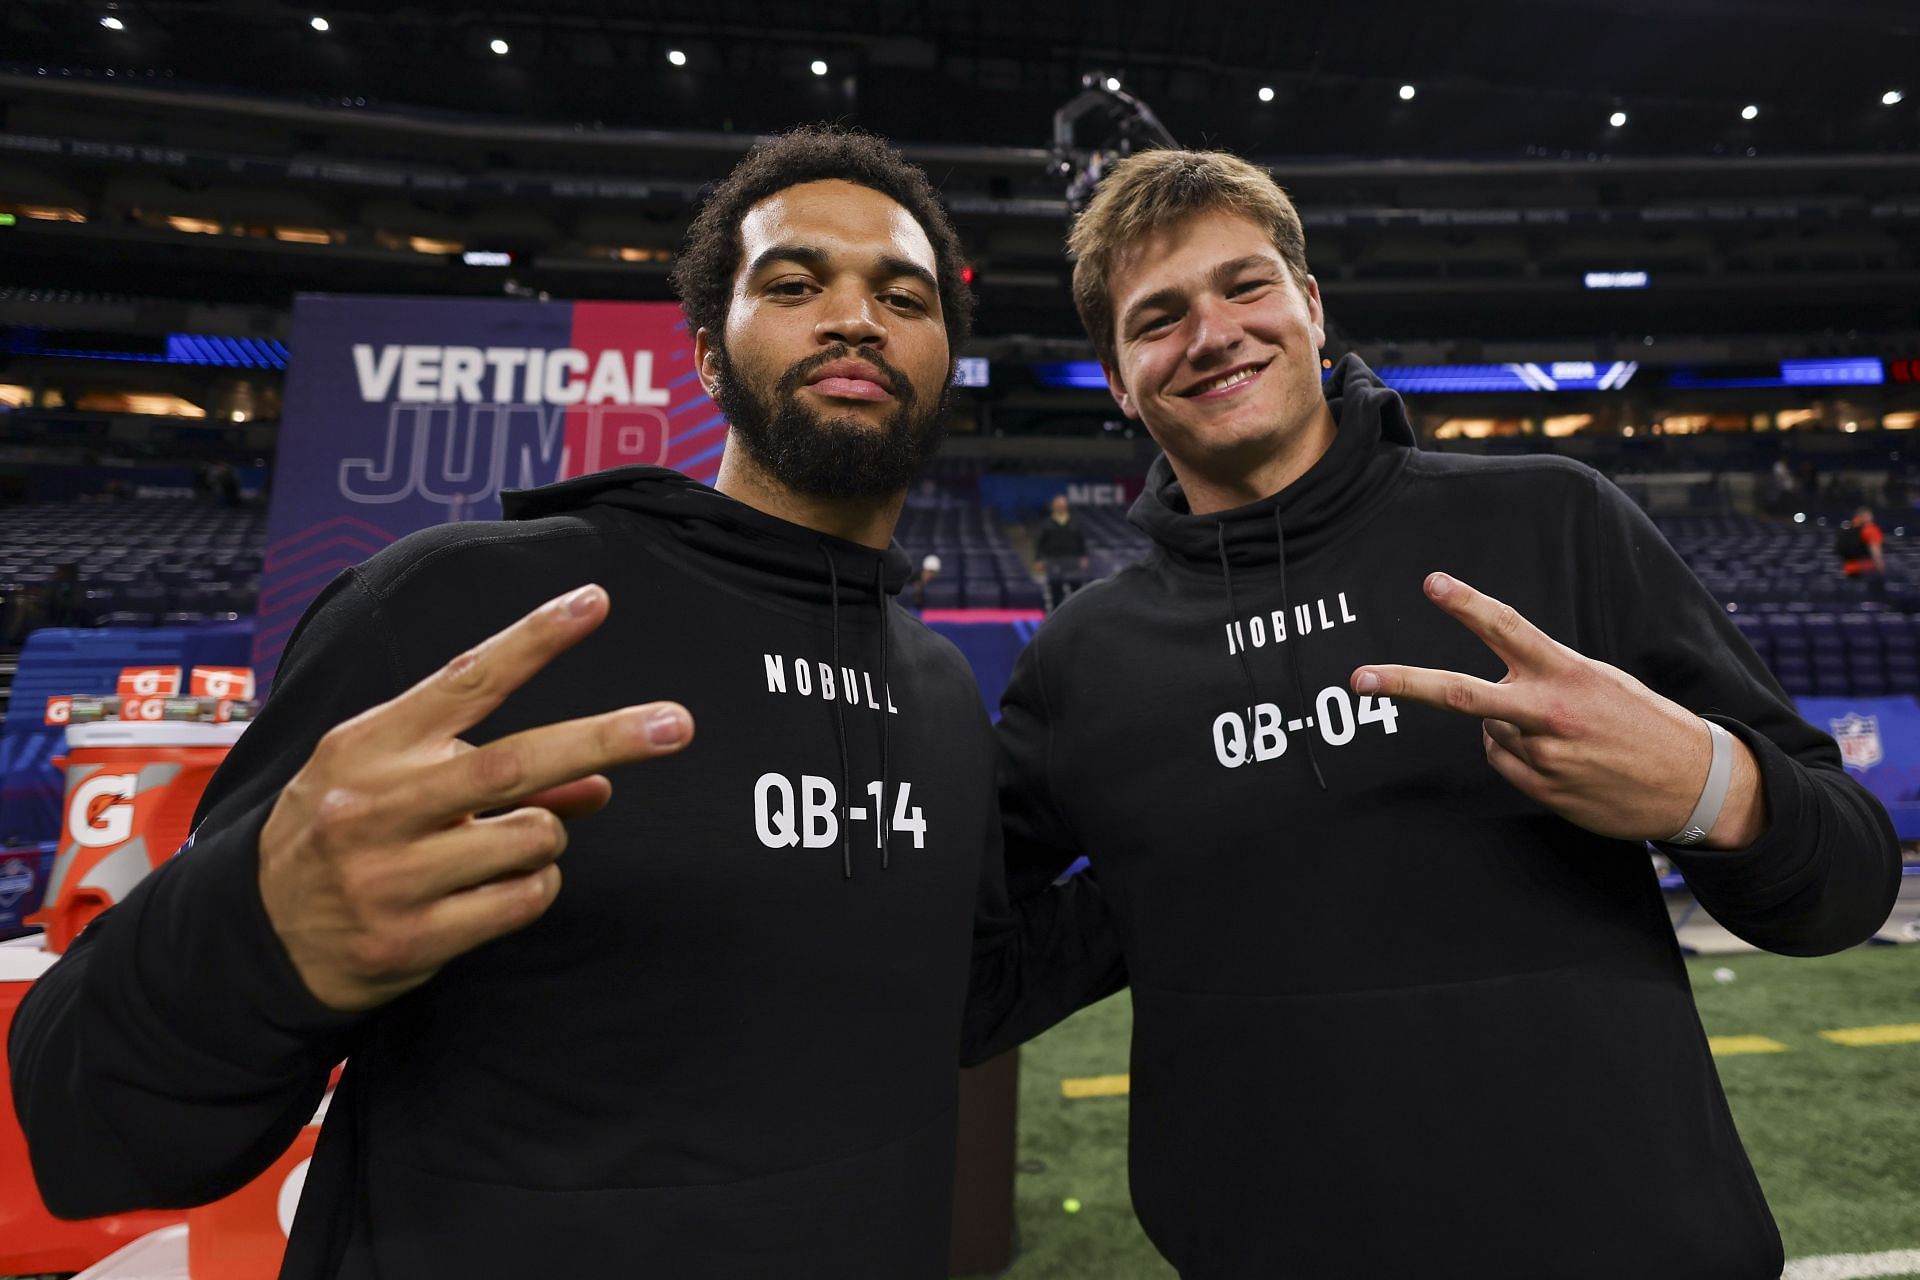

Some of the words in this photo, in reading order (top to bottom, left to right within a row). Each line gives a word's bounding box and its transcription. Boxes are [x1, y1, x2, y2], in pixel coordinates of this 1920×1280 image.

[352, 343, 670, 406] VERTICAL
[1226, 592, 1357, 655] NOBULL
[764, 654, 898, 714] NOBULL
[1212, 686, 1399, 769] QB-04
[69, 773, 139, 848] G
[754, 772, 927, 849] QB-14
